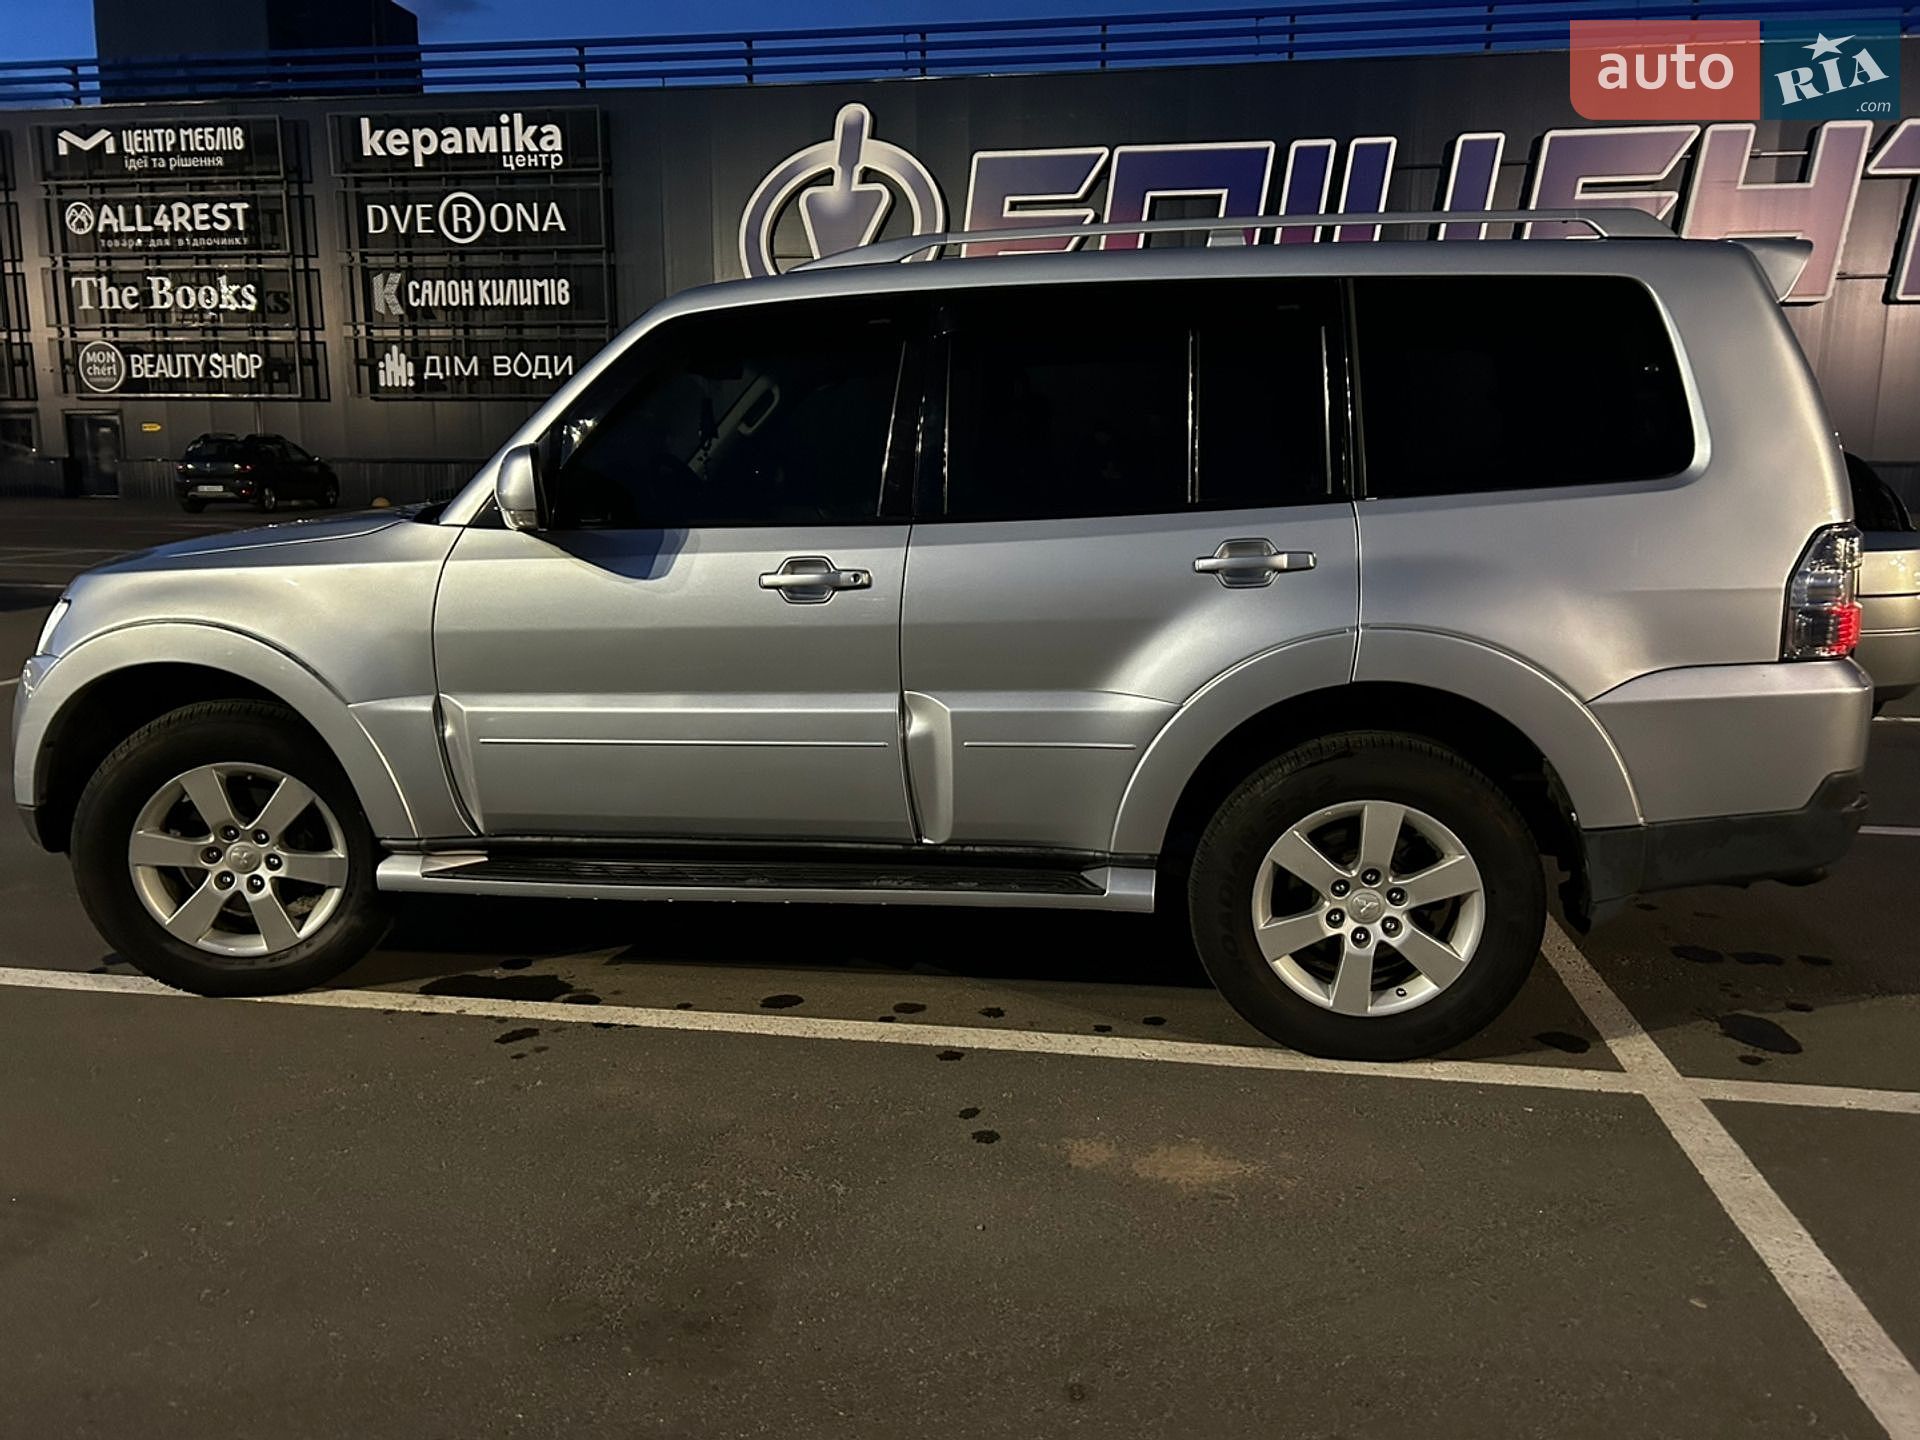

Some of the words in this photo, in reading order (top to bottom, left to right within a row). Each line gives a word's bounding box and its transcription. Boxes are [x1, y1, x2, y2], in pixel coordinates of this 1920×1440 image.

[122, 128, 176, 155] ЦЕНТР
[179, 126, 245, 152] МЕБЛІВ
[123, 155, 150, 171] ідеї
[151, 156, 167, 169] та
[169, 154, 224, 171] рішення
[502, 152, 564, 171] центр
[97, 201, 250, 233] ALL4REST
[71, 275, 140, 310] The
[147, 274, 258, 312] Books
[408, 279, 475, 307] САЛОН
[478, 278, 571, 306] КИЛИМІВ
[86, 351, 116, 363] MON
[130, 353, 207, 379] BEAUTY
[208, 352, 264, 379] SHOP
[423, 355, 479, 380] ДІМ
[493, 351, 574, 380] ВОДИ
